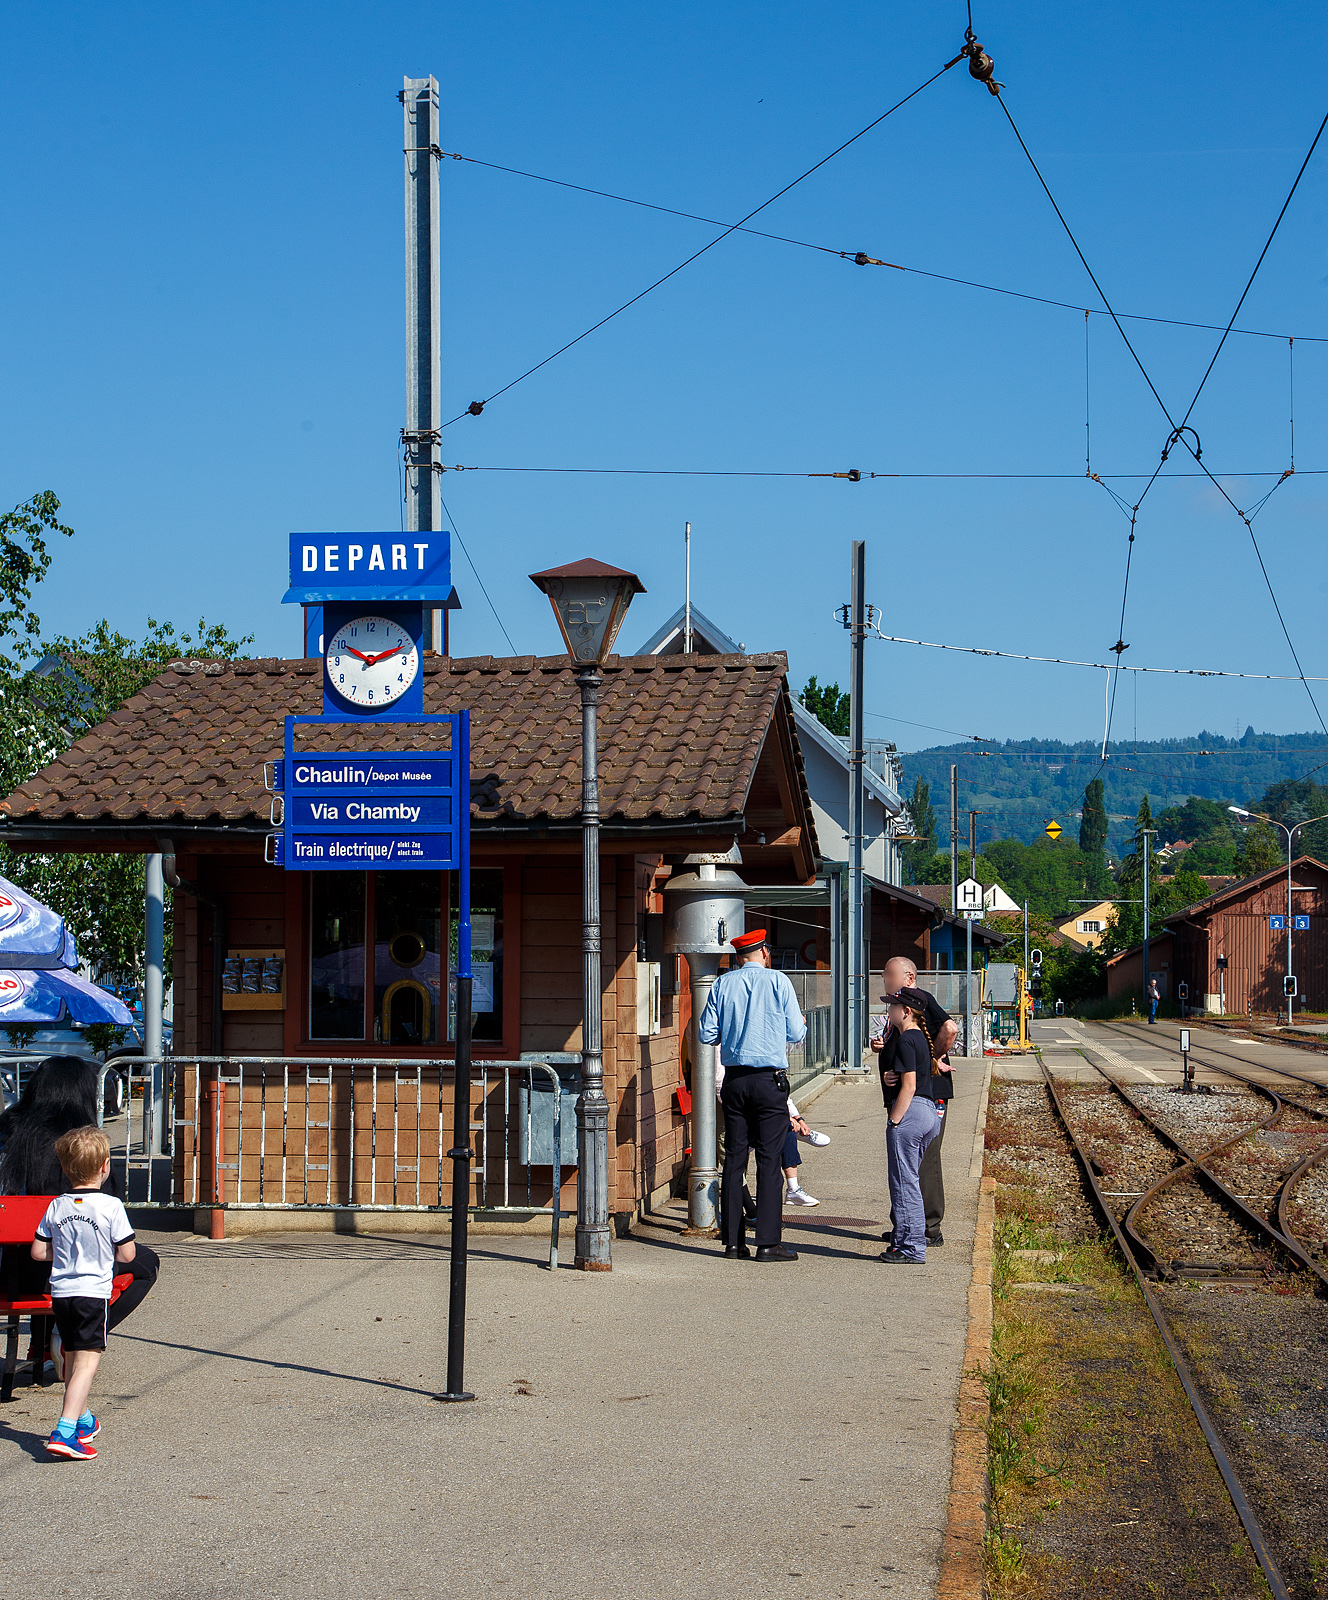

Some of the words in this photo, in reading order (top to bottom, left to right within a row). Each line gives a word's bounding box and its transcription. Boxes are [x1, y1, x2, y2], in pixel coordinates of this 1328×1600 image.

[302, 543, 429, 572] DEPART
[351, 627, 357, 637] 11
[366, 622, 375, 632] 12
[386, 626, 389, 637] 1
[337, 639, 346, 650] 10
[334, 656, 340, 666] 9
[401, 656, 407, 666] 3
[339, 673, 345, 683] 8
[397, 673, 403, 683] 4
[351, 685, 357, 695] 7
[368, 690, 374, 700] 6
[384, 685, 390, 695] 5
[402, 771, 432, 781] Musée
[310, 803, 339, 820] Via
[345, 802, 421, 823] Chamby
[294, 841, 324, 857] Train
[329, 840, 395, 860] électrique/
[963, 885, 976, 902] H
